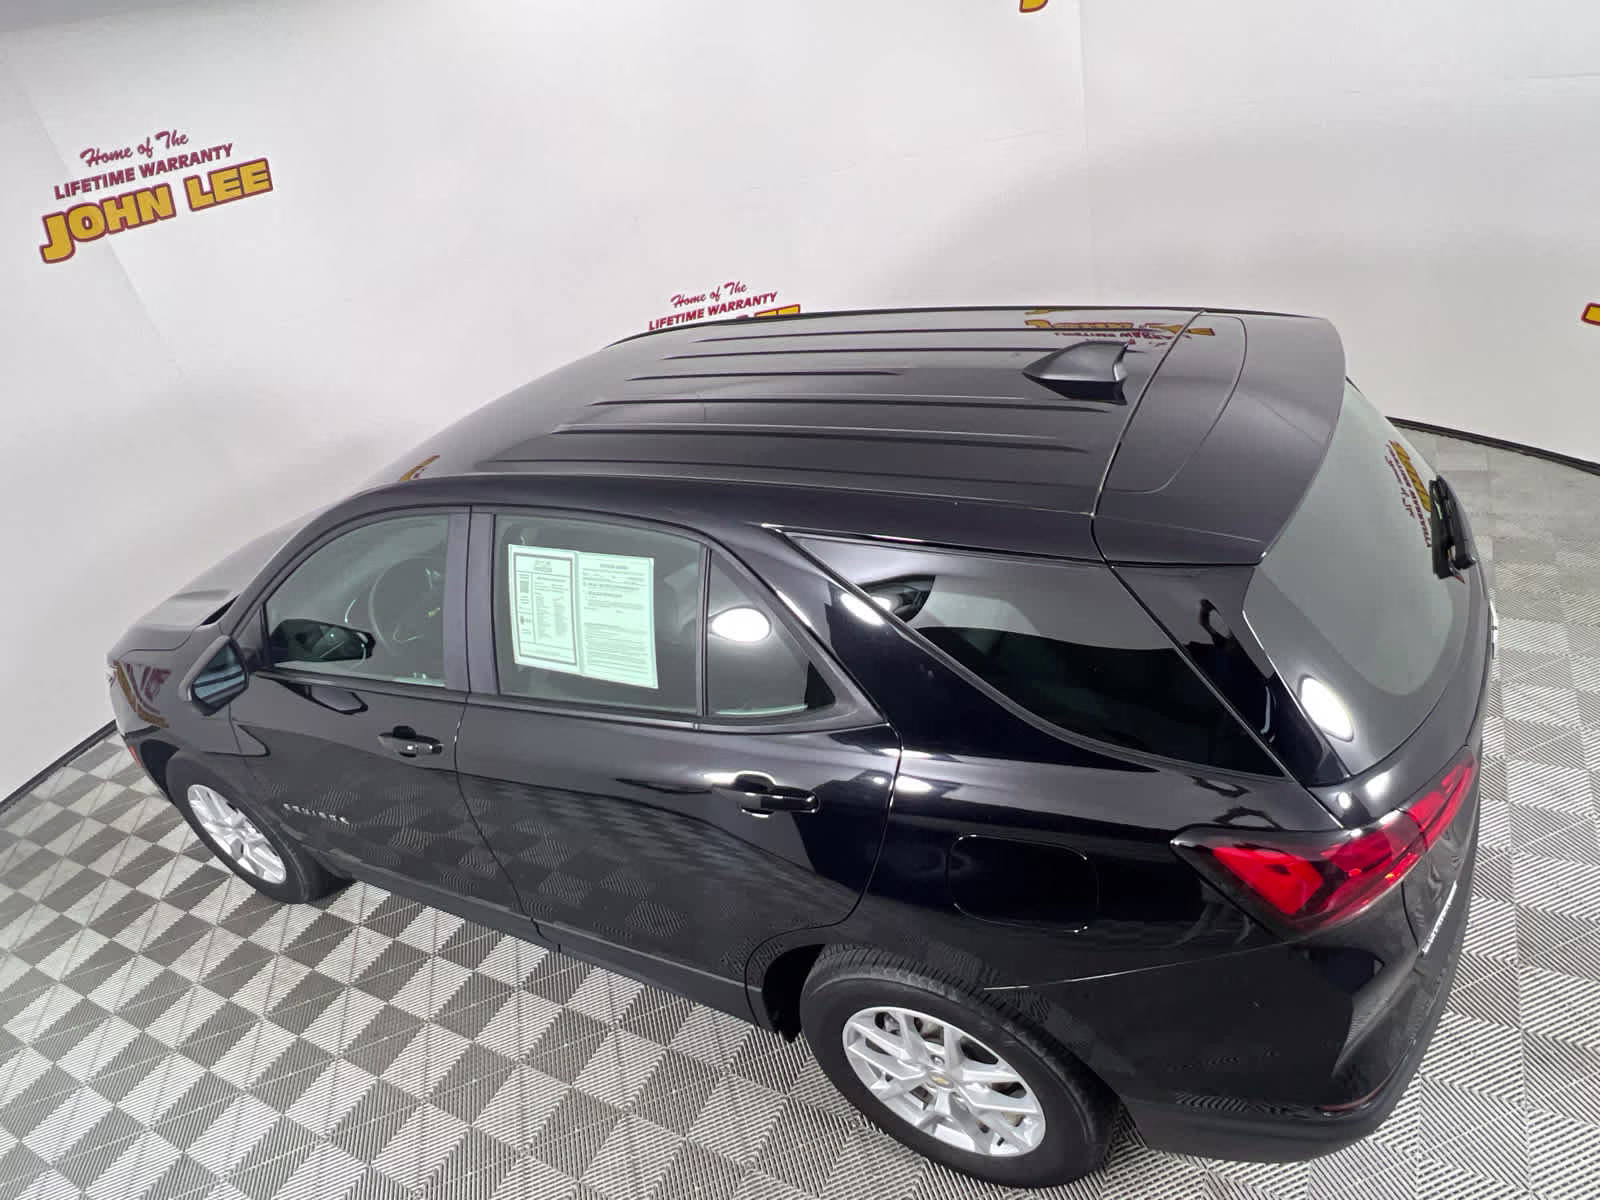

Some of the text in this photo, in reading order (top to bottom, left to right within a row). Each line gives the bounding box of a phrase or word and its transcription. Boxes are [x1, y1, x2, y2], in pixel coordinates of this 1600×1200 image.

[79, 130, 189, 168] Home of The
[54, 143, 233, 200] LIFETIME WARRANTY
[39, 158, 273, 264] JOHN LEE
[648, 308, 704, 330] LIFETIME
[708, 292, 777, 319] WARRANTY
[670, 281, 747, 309] Home of The
